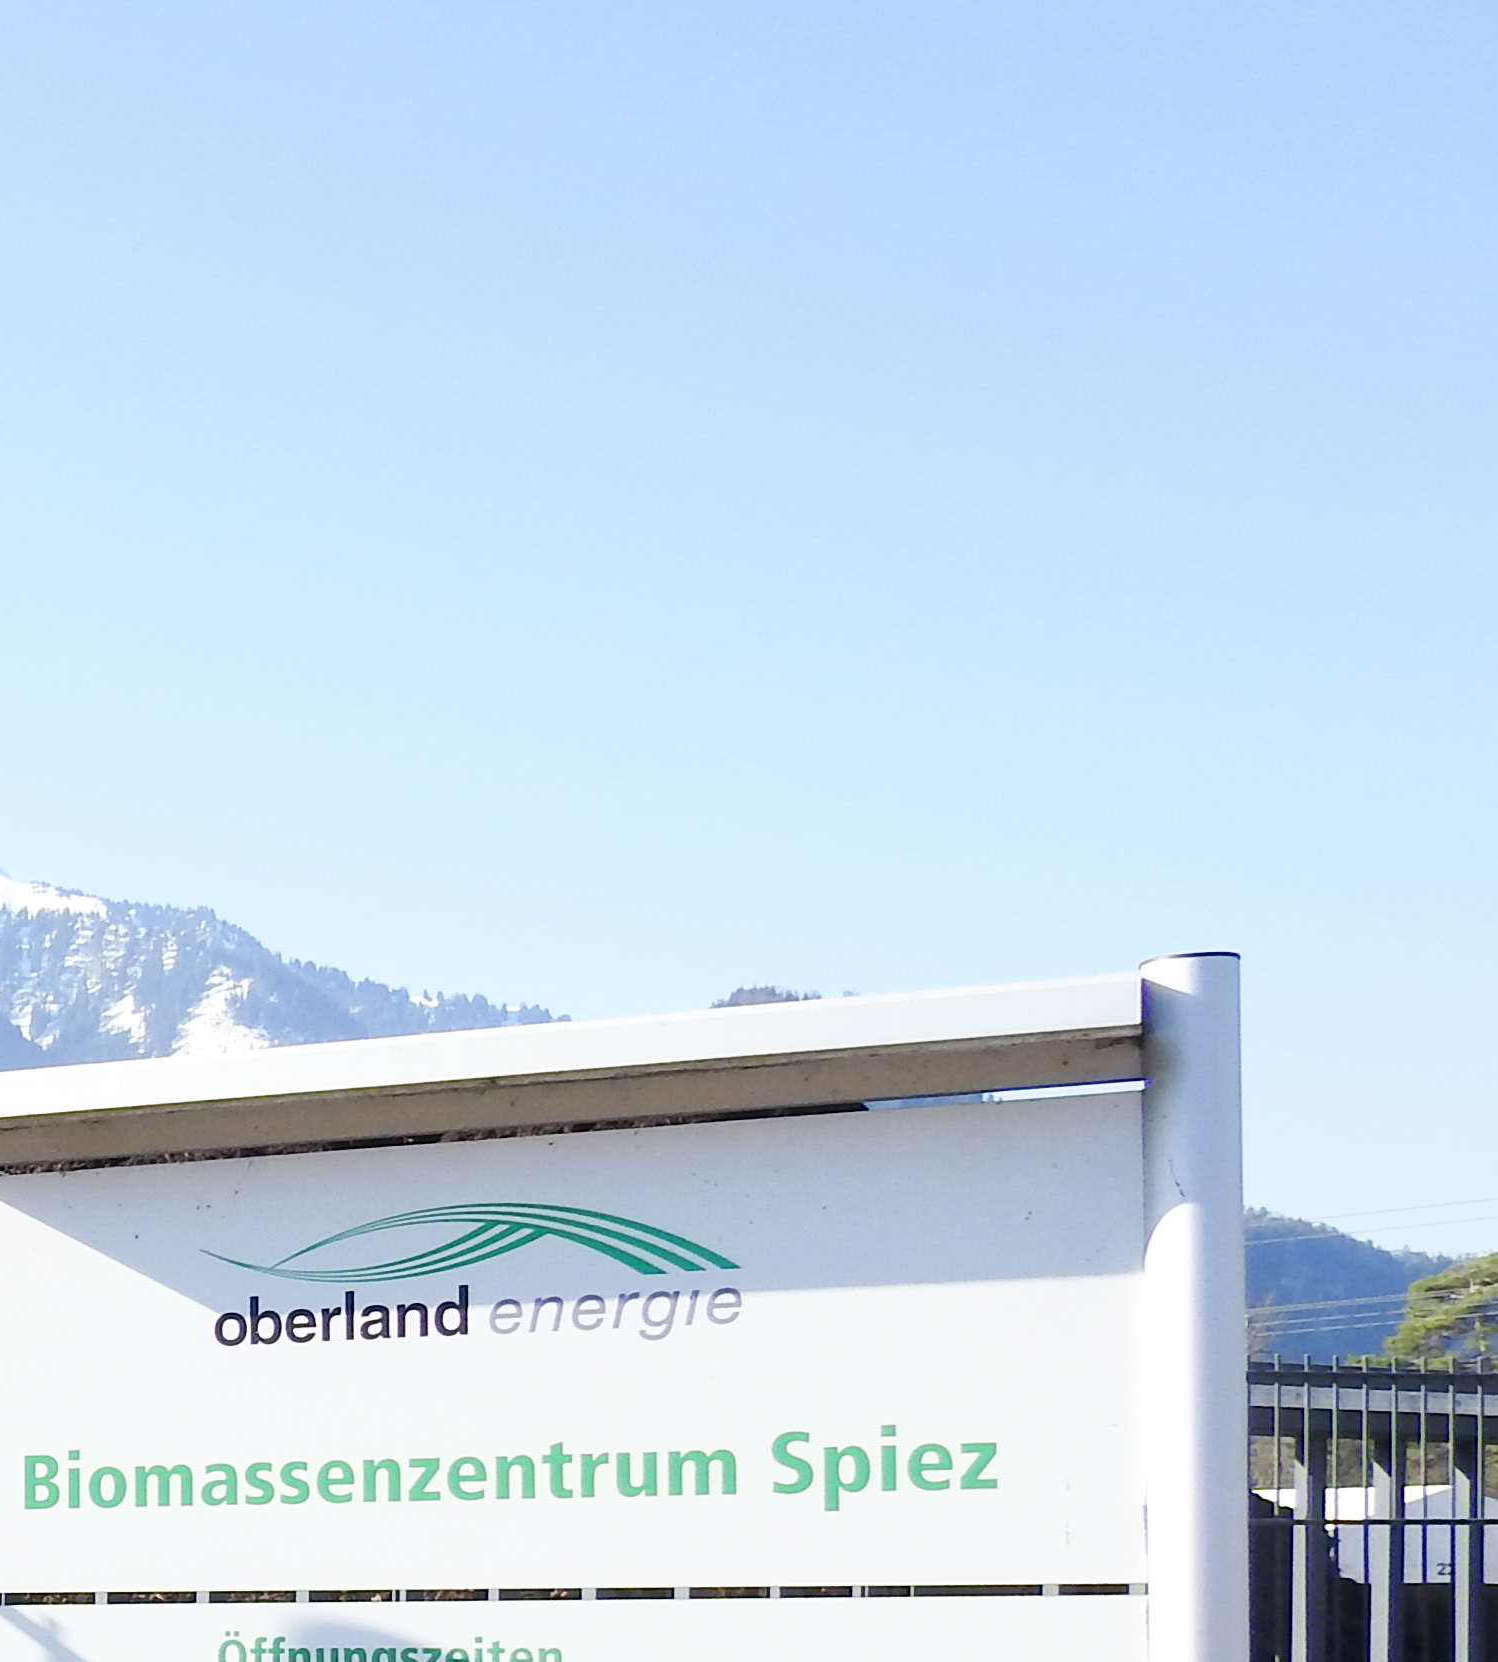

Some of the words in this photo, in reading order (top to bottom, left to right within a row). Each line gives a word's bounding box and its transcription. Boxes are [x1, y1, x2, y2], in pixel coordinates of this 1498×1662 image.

[214, 1285, 470, 1346] oberland
[488, 1285, 744, 1341] energie
[21, 1442, 739, 1511] Biomassenzentrum
[770, 1425, 999, 1512] Spiez
